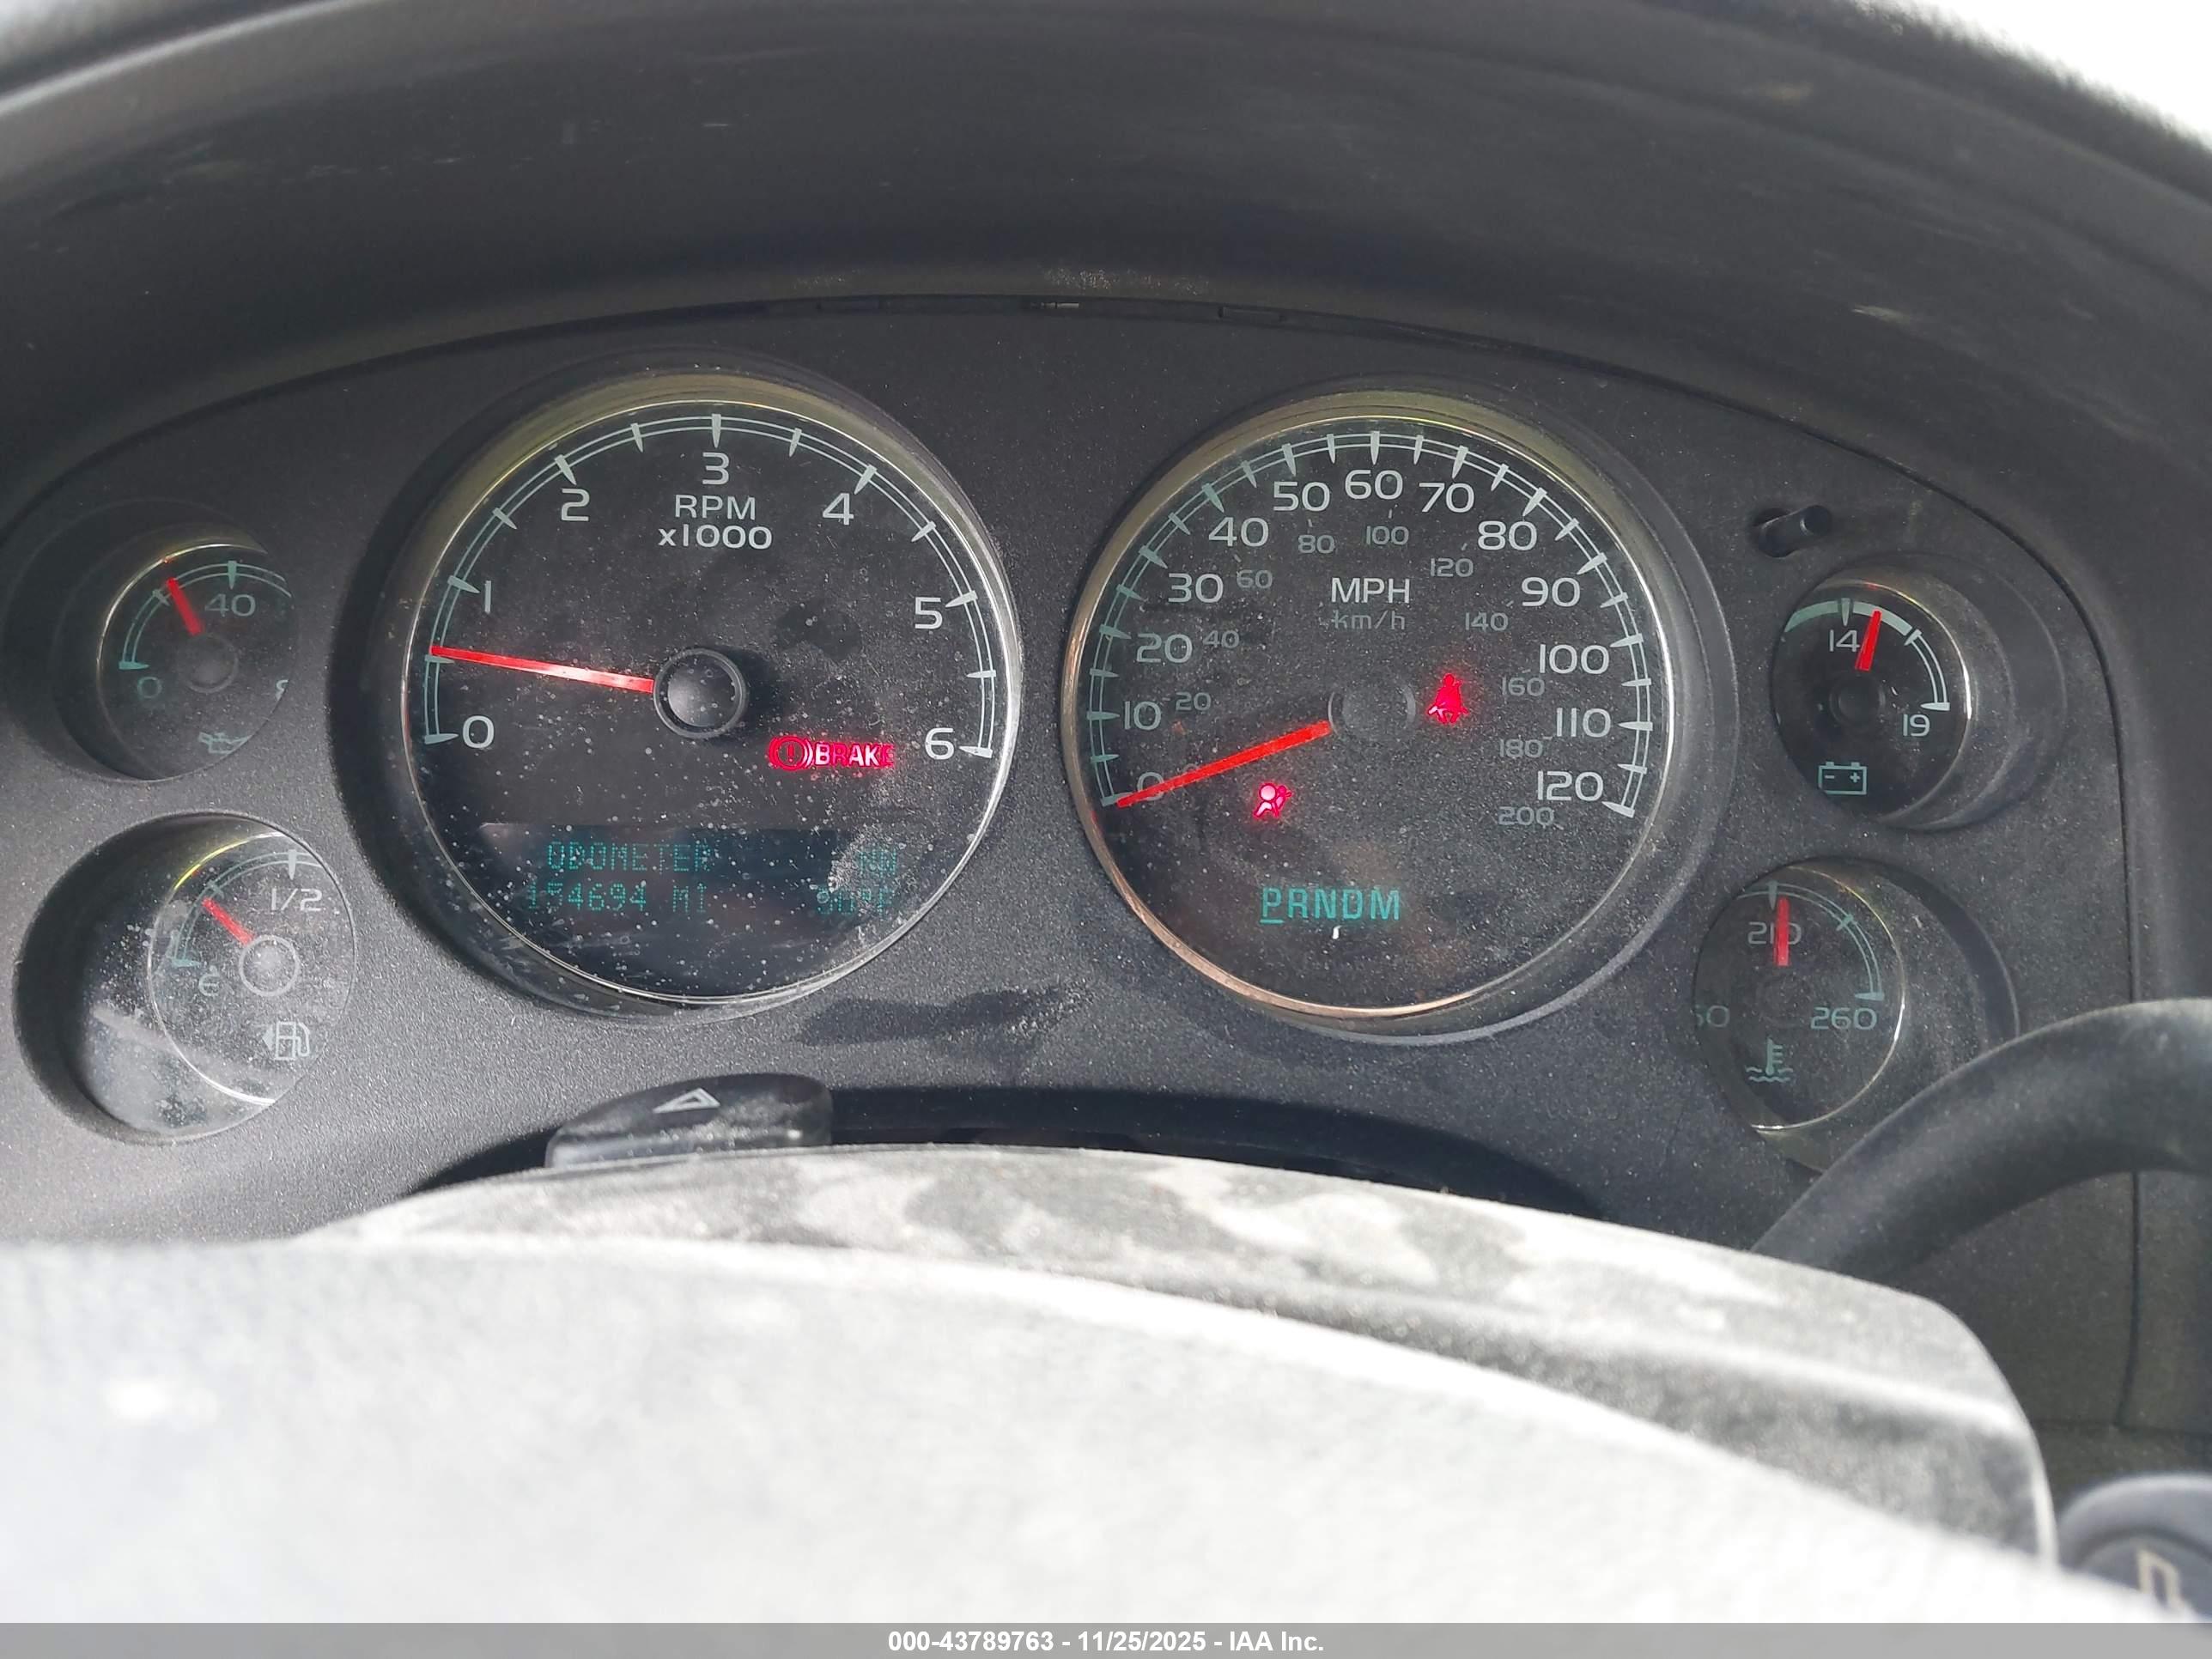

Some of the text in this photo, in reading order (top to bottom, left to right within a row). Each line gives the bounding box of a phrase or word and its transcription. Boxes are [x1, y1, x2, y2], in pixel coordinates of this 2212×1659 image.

[702, 452, 730, 485] 3
[1273, 482, 1329, 513] 50
[1346, 470, 1402, 501] 60
[1419, 483, 1474, 513] 70
[561, 488, 590, 521] 2
[675, 495, 756, 520] RPM
[822, 493, 854, 526] 4
[658, 525, 773, 550] x1000
[1209, 517, 1268, 547] 40
[1297, 534, 1335, 555] 80
[1365, 526, 1409, 546] 100
[1478, 521, 1537, 551] 80
[1237, 569, 1273, 589] 60
[1430, 557, 1474, 578] 120
[483, 580, 492, 613] 1
[1167, 573, 1224, 603] 30
[1331, 578, 1410, 603] MPH
[1522, 577, 1580, 608] 90
[204, 593, 256, 617] 40
[915, 597, 943, 629] 5
[1333, 610, 1406, 630] km/h
[1464, 611, 1509, 631] 140
[1136, 634, 1193, 663] 20
[1202, 629, 1240, 650] 40
[1829, 629, 1860, 653] 14
[1539, 644, 1610, 674] 100
[137, 677, 162, 698] 0
[1503, 677, 1546, 696] 160
[1176, 692, 1212, 713] 20
[1123, 701, 1161, 730] 10
[1557, 708, 1611, 738] 110
[1903, 714, 1930, 737] 19
[462, 715, 495, 749] 0
[925, 727, 955, 760] 6
[816, 743, 894, 768] BRAKE
[1500, 738, 1543, 758] 180
[1537, 771, 1603, 801] 120
[1498, 806, 1554, 827] 200
[547, 841, 712, 874] ODOMETER
[270, 888, 322, 912] 1/2
[1810, 1007, 1878, 1030] 260
